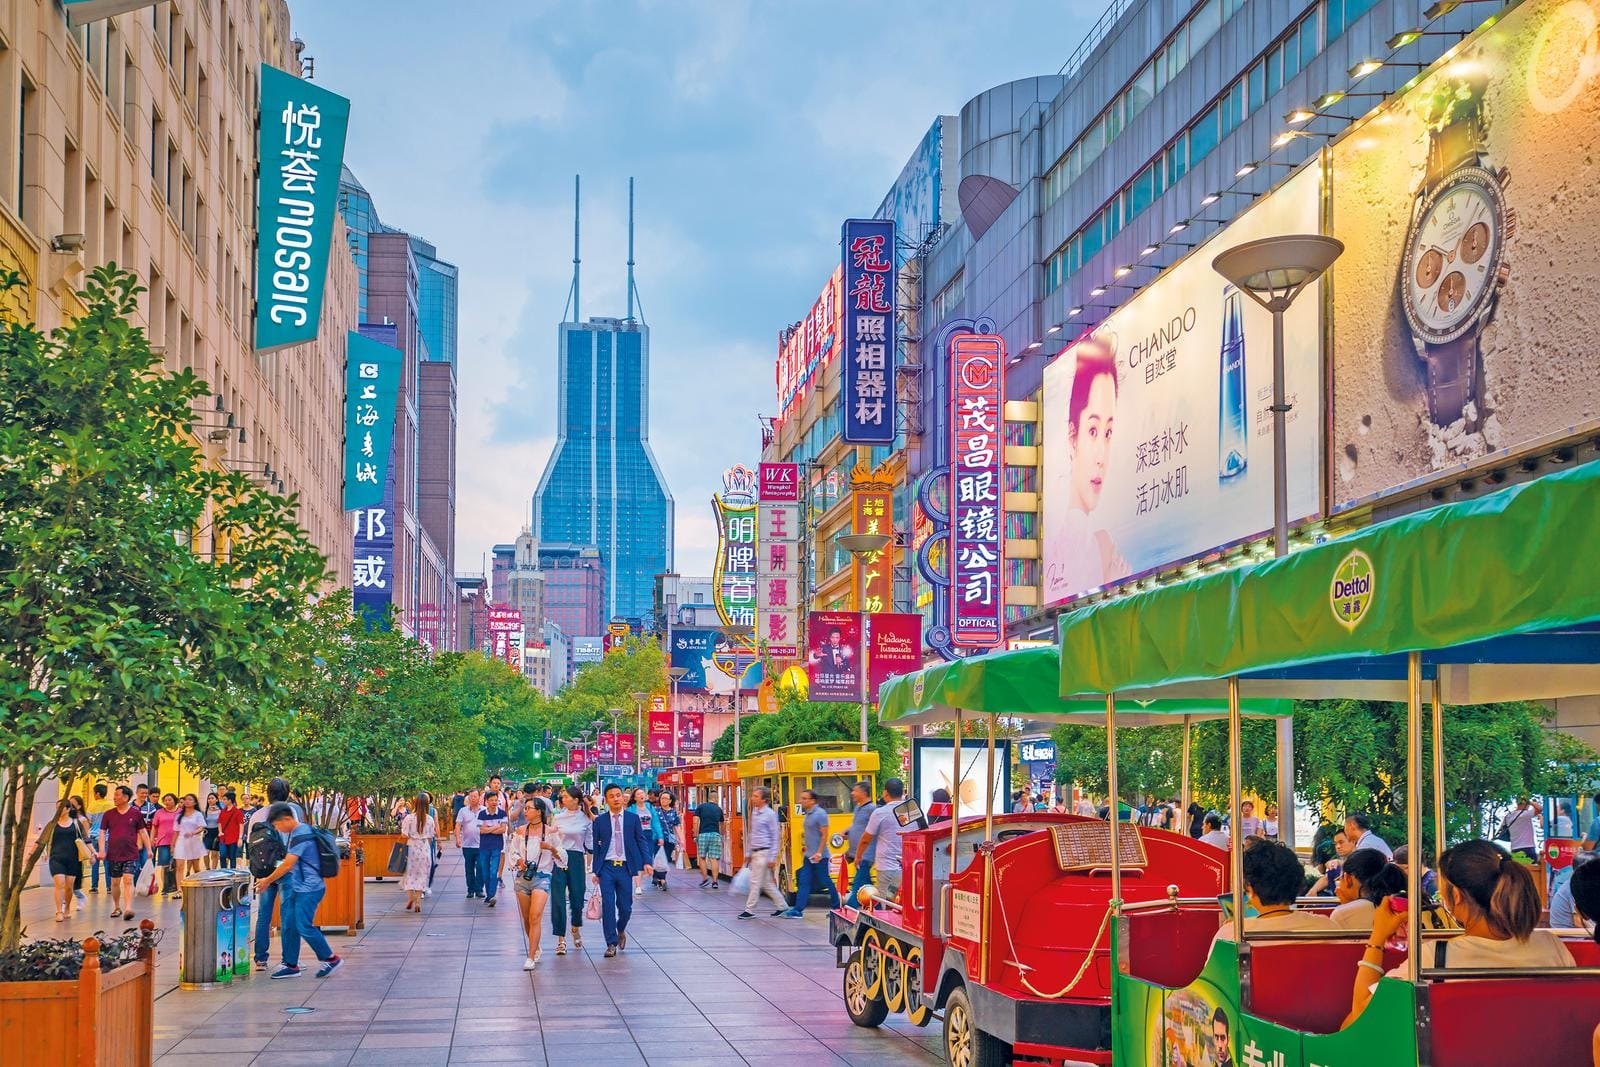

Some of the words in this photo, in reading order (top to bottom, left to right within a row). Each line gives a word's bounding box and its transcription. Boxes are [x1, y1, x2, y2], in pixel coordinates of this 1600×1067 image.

[281, 101, 322, 195] 悦荟
[270, 197, 316, 327] mosaic
[1128, 306, 1196, 369] CHANDO
[1145, 348, 1178, 385] 自然堂
[1135, 421, 1189, 474] 深透补水
[960, 397, 997, 605] 茂昌眼镜公司
[1135, 465, 1190, 516] 活力冰肌
[1334, 574, 1370, 599] Dettol
[877, 632, 912, 644] Madame
[877, 643, 912, 653] Tussauds
[958, 617, 998, 628] OPTICAL
